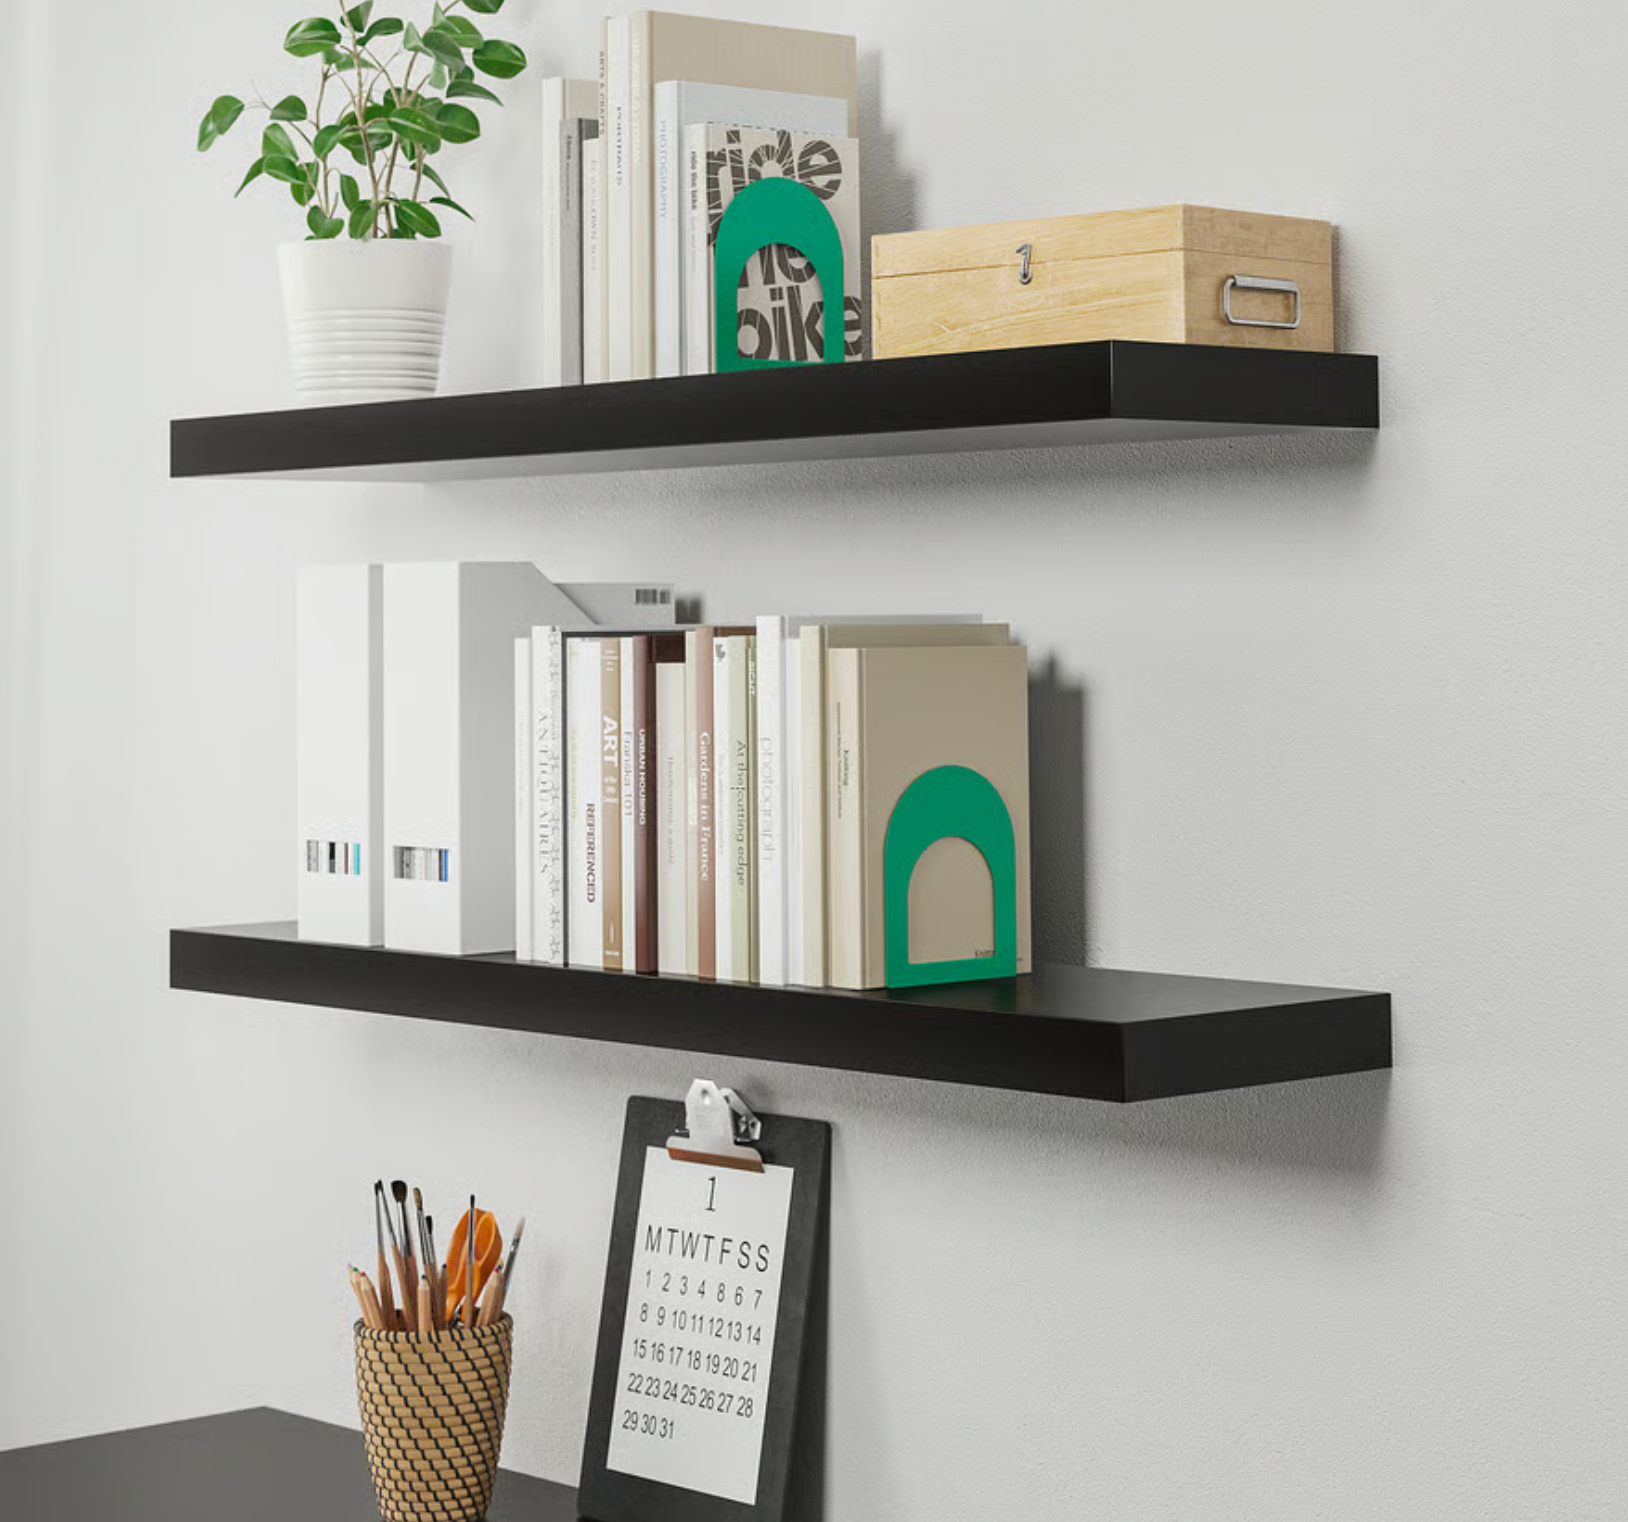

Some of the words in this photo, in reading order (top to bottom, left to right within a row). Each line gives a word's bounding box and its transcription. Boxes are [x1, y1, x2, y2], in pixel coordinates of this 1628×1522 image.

[659, 119, 668, 220] PHOTOGRAPHY
[690, 151, 698, 170] ride
[690, 172, 698, 188] the
[690, 190, 698, 211] bike
[603, 715, 618, 768] ART
[624, 731, 632, 786] Franska
[638, 729, 646, 769] URBAN
[737, 740, 746, 759] At
[700, 731, 710, 799] Gardens
[737, 761, 747, 786] the
[842, 749, 850, 787] Knitting
[537, 710, 548, 874] ANTIQUAIRES
[624, 793, 632, 816] 101
[638, 771, 646, 825] HOUSING
[700, 804, 710, 820] in
[759, 737, 777, 861] photograph
[735, 789, 747, 843] cutting
[586, 803, 595, 904] REFERENCED
[700, 826, 710, 882] France
[735, 845, 748, 886] edge
[705, 1175, 717, 1213] 1
[645, 1269, 652, 1289] 1
[660, 1272, 672, 1294] 2
[679, 1275, 689, 1297] 3
[696, 1279, 707, 1299] 4
[734, 1285, 745, 1307] 6
[753, 1289, 763, 1311] 7
[639, 1302, 649, 1323] 8
[656, 1305, 667, 1327] 9
[671, 1309, 687, 1331] 10
[690, 1313, 705, 1334] 11
[707, 1316, 724, 1339] 12
[726, 1320, 743, 1343] 13
[745, 1324, 763, 1347] 14
[632, 1338, 648, 1360] 15
[650, 1341, 666, 1364] 16
[668, 1345, 684, 1366] 17
[686, 1349, 702, 1371] 18
[704, 1353, 721, 1375] 19
[721, 1355, 739, 1380] 20
[740, 1360, 758, 1383] 21
[626, 1372, 644, 1395] 22
[644, 1375, 661, 1399] 23
[662, 1379, 679, 1402] 24
[679, 1383, 698, 1406] 25
[697, 1387, 716, 1411] 26
[716, 1391, 735, 1414] 27
[735, 1395, 754, 1419] 28
[621, 1408, 639, 1432] 29
[640, 1413, 657, 1436] 30
[658, 1417, 675, 1440] 31
